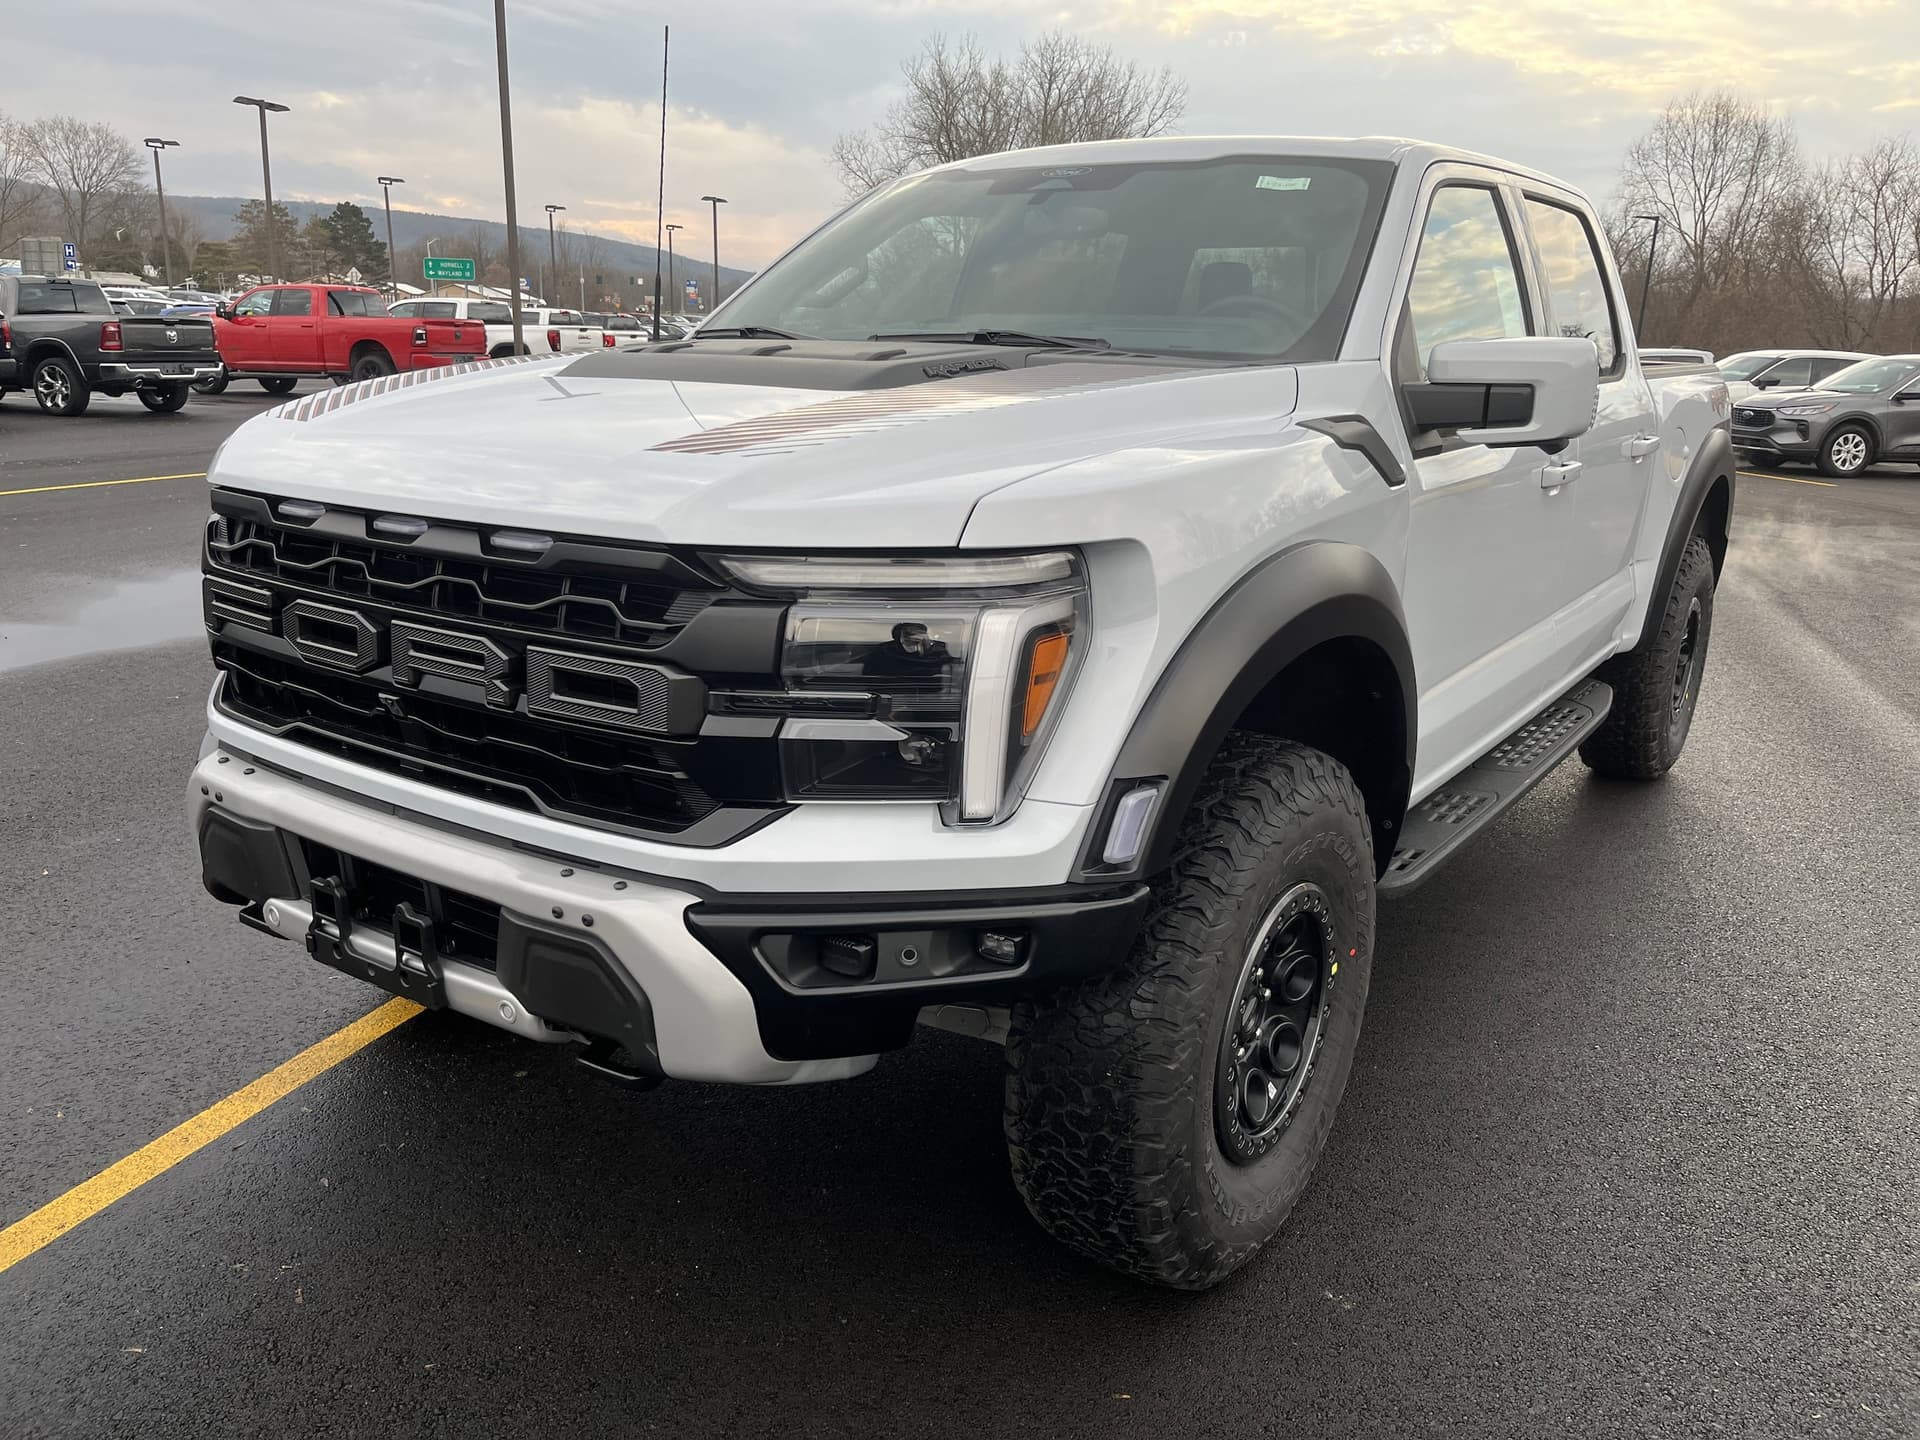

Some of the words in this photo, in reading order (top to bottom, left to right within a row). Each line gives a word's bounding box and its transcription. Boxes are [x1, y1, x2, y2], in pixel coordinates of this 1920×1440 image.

[65, 245, 74, 257] H
[922, 358, 1007, 379] RAPTOR
[203, 575, 690, 736] FORD
